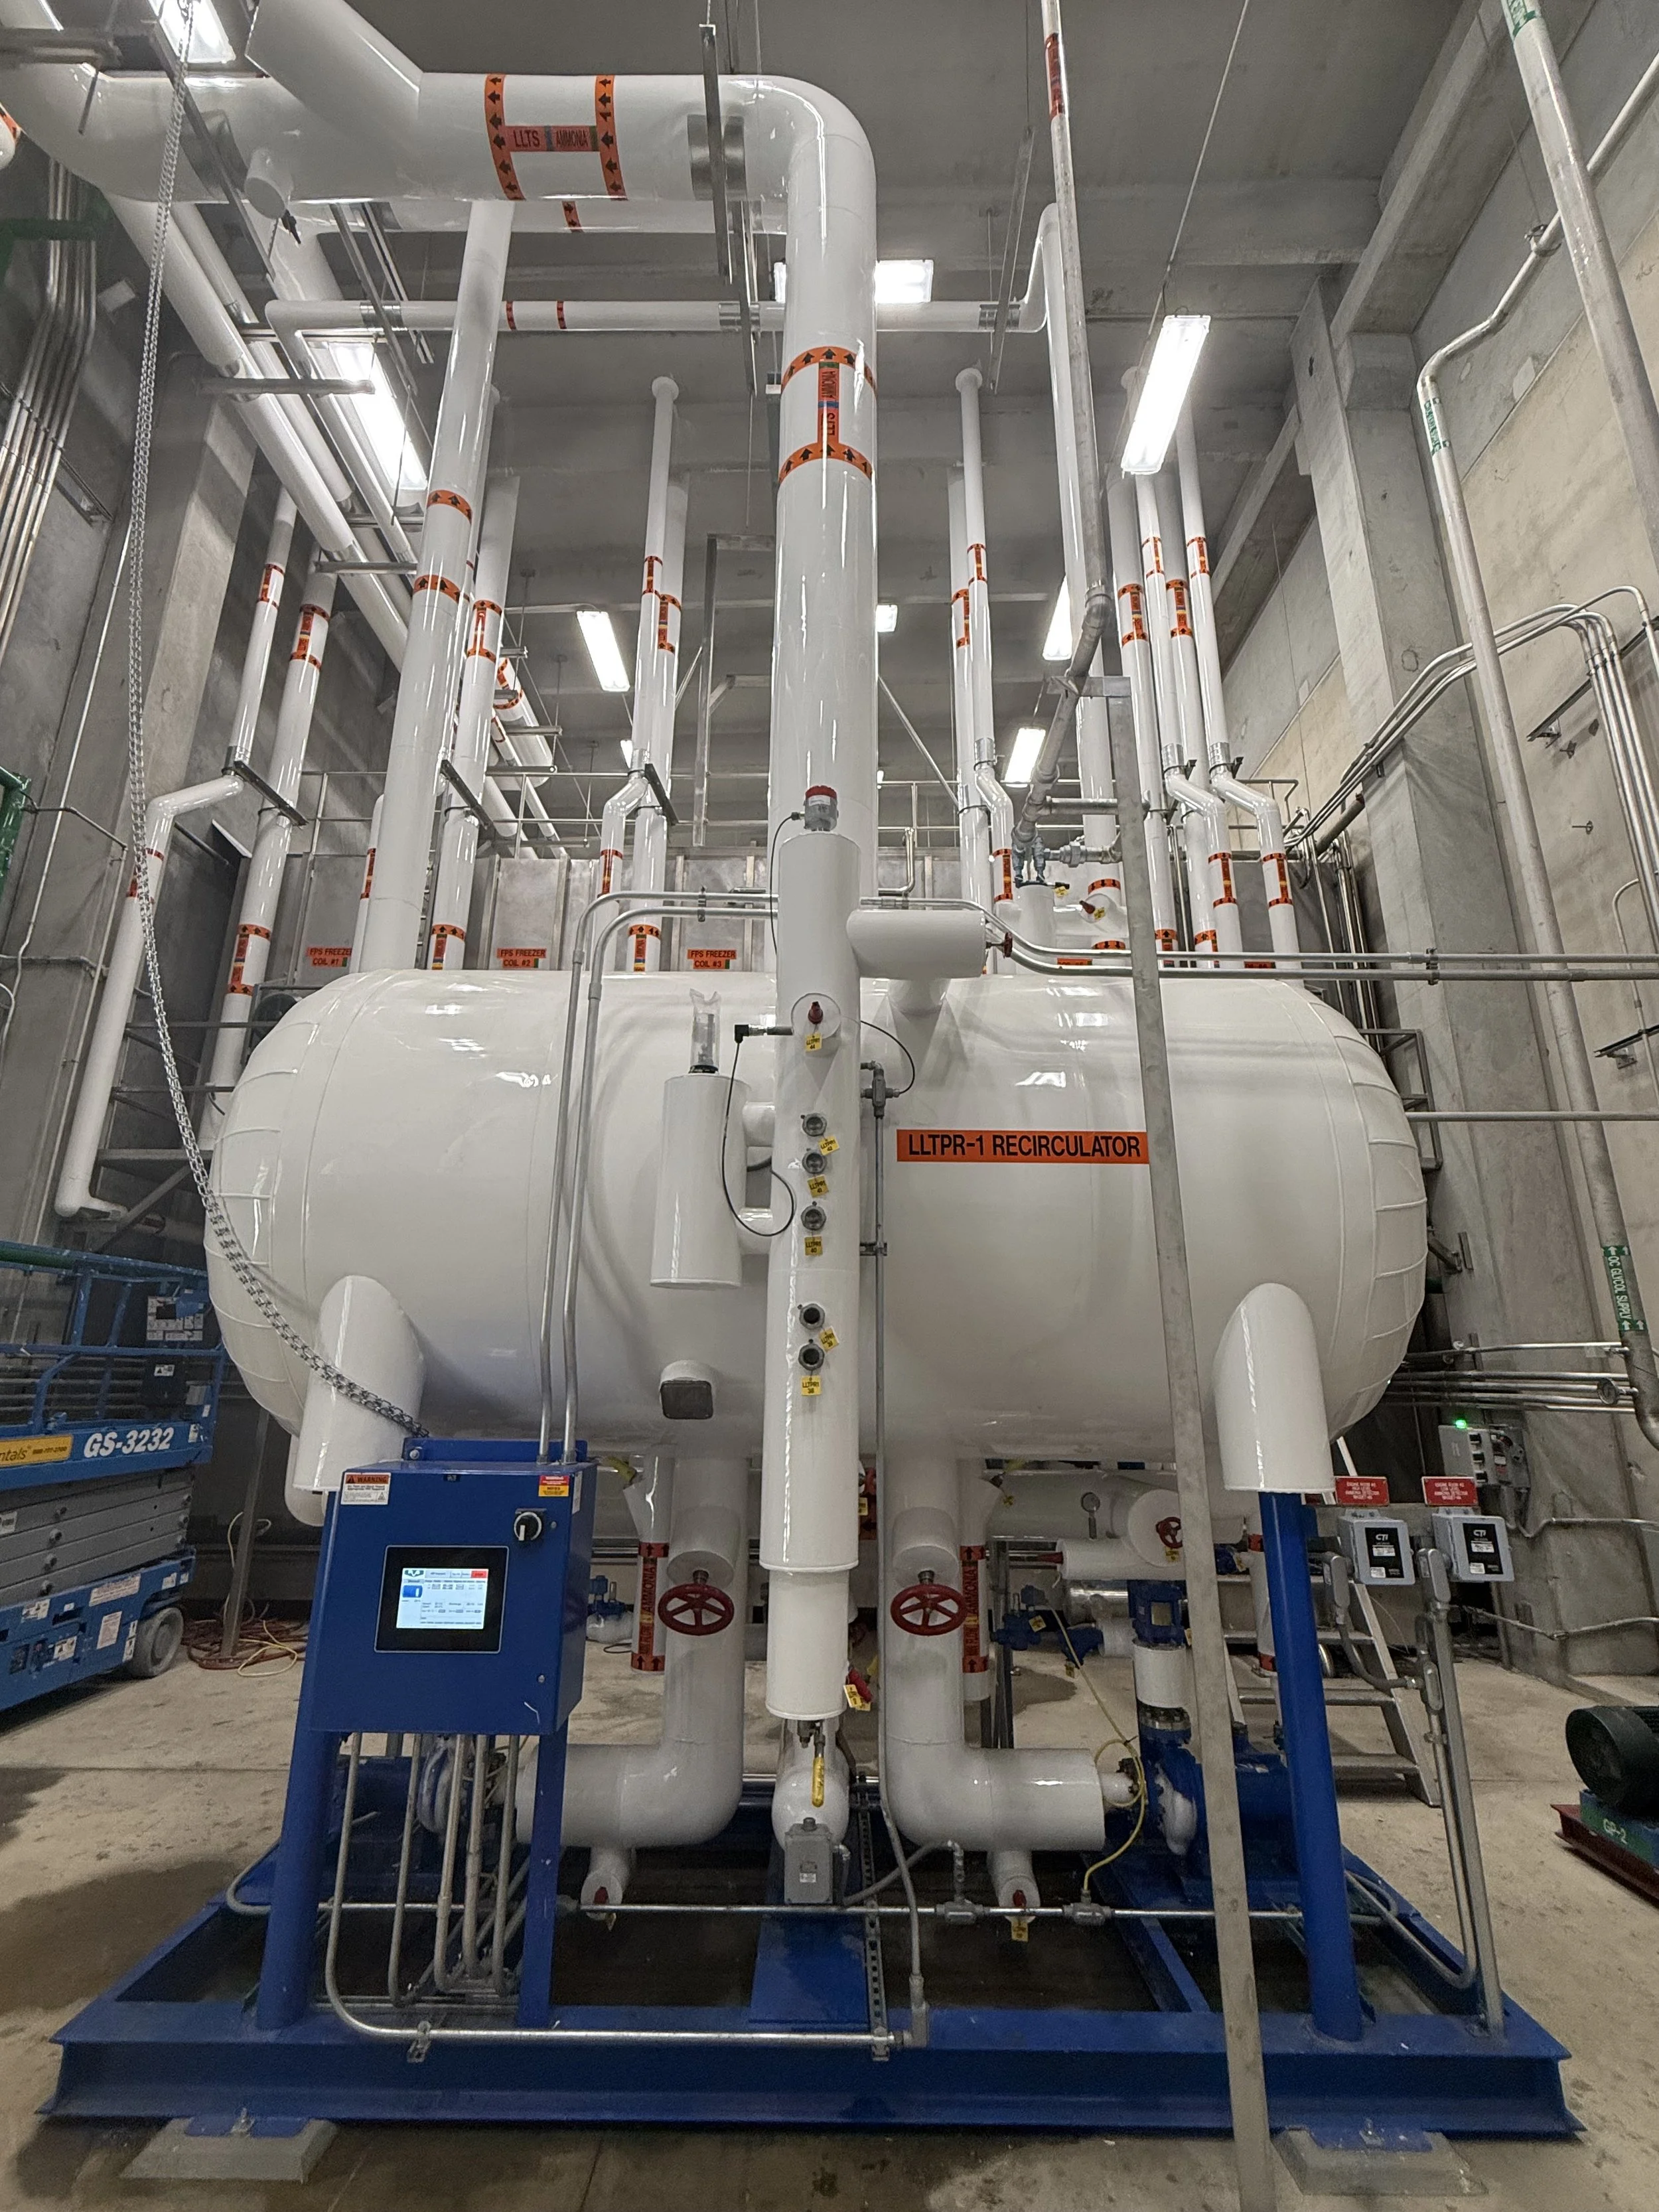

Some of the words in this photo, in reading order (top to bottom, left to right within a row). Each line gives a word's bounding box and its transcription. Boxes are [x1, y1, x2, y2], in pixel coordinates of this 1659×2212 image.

[513, 129, 540, 147] LLTS
[555, 129, 589, 147] AMMONIA
[822, 370, 836, 399] AMMONIA
[908, 1134, 984, 1156] LLTPR-1
[992, 1135, 1141, 1157] RECIRCULATOR
[1608, 1256, 1621, 1267] OC
[1611, 1268, 1626, 1293] GLYCOL
[1616, 1295, 1632, 1319] SUPPLY
[84, 1427, 175, 1459] GS-3232
[642, 1566, 656, 1613] AMMONIA
[964, 1568, 978, 1613] AMMONIA
